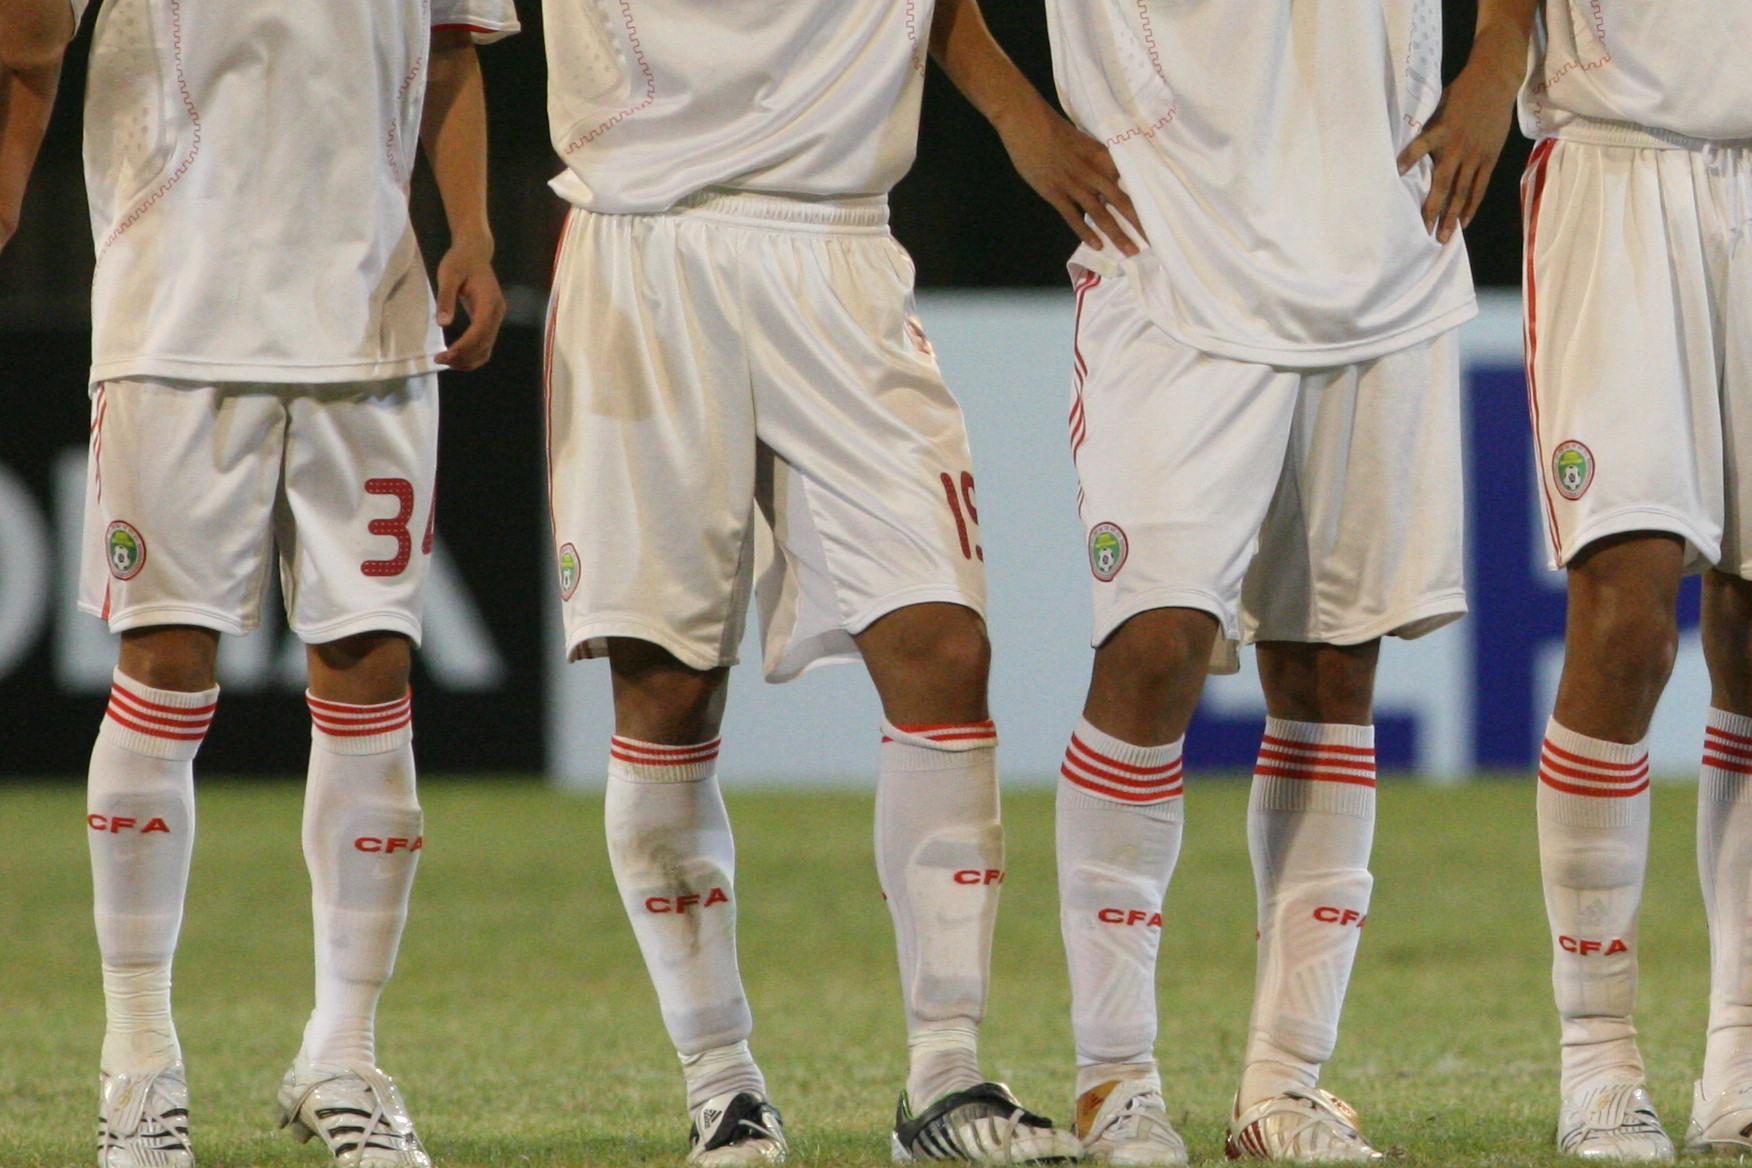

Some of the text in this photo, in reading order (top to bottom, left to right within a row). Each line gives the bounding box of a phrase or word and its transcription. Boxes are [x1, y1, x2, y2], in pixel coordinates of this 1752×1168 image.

[360, 477, 436, 577] 3
[87, 813, 170, 834] CFA
[645, 887, 728, 915] CFA
[1558, 935, 1629, 956] CFA
